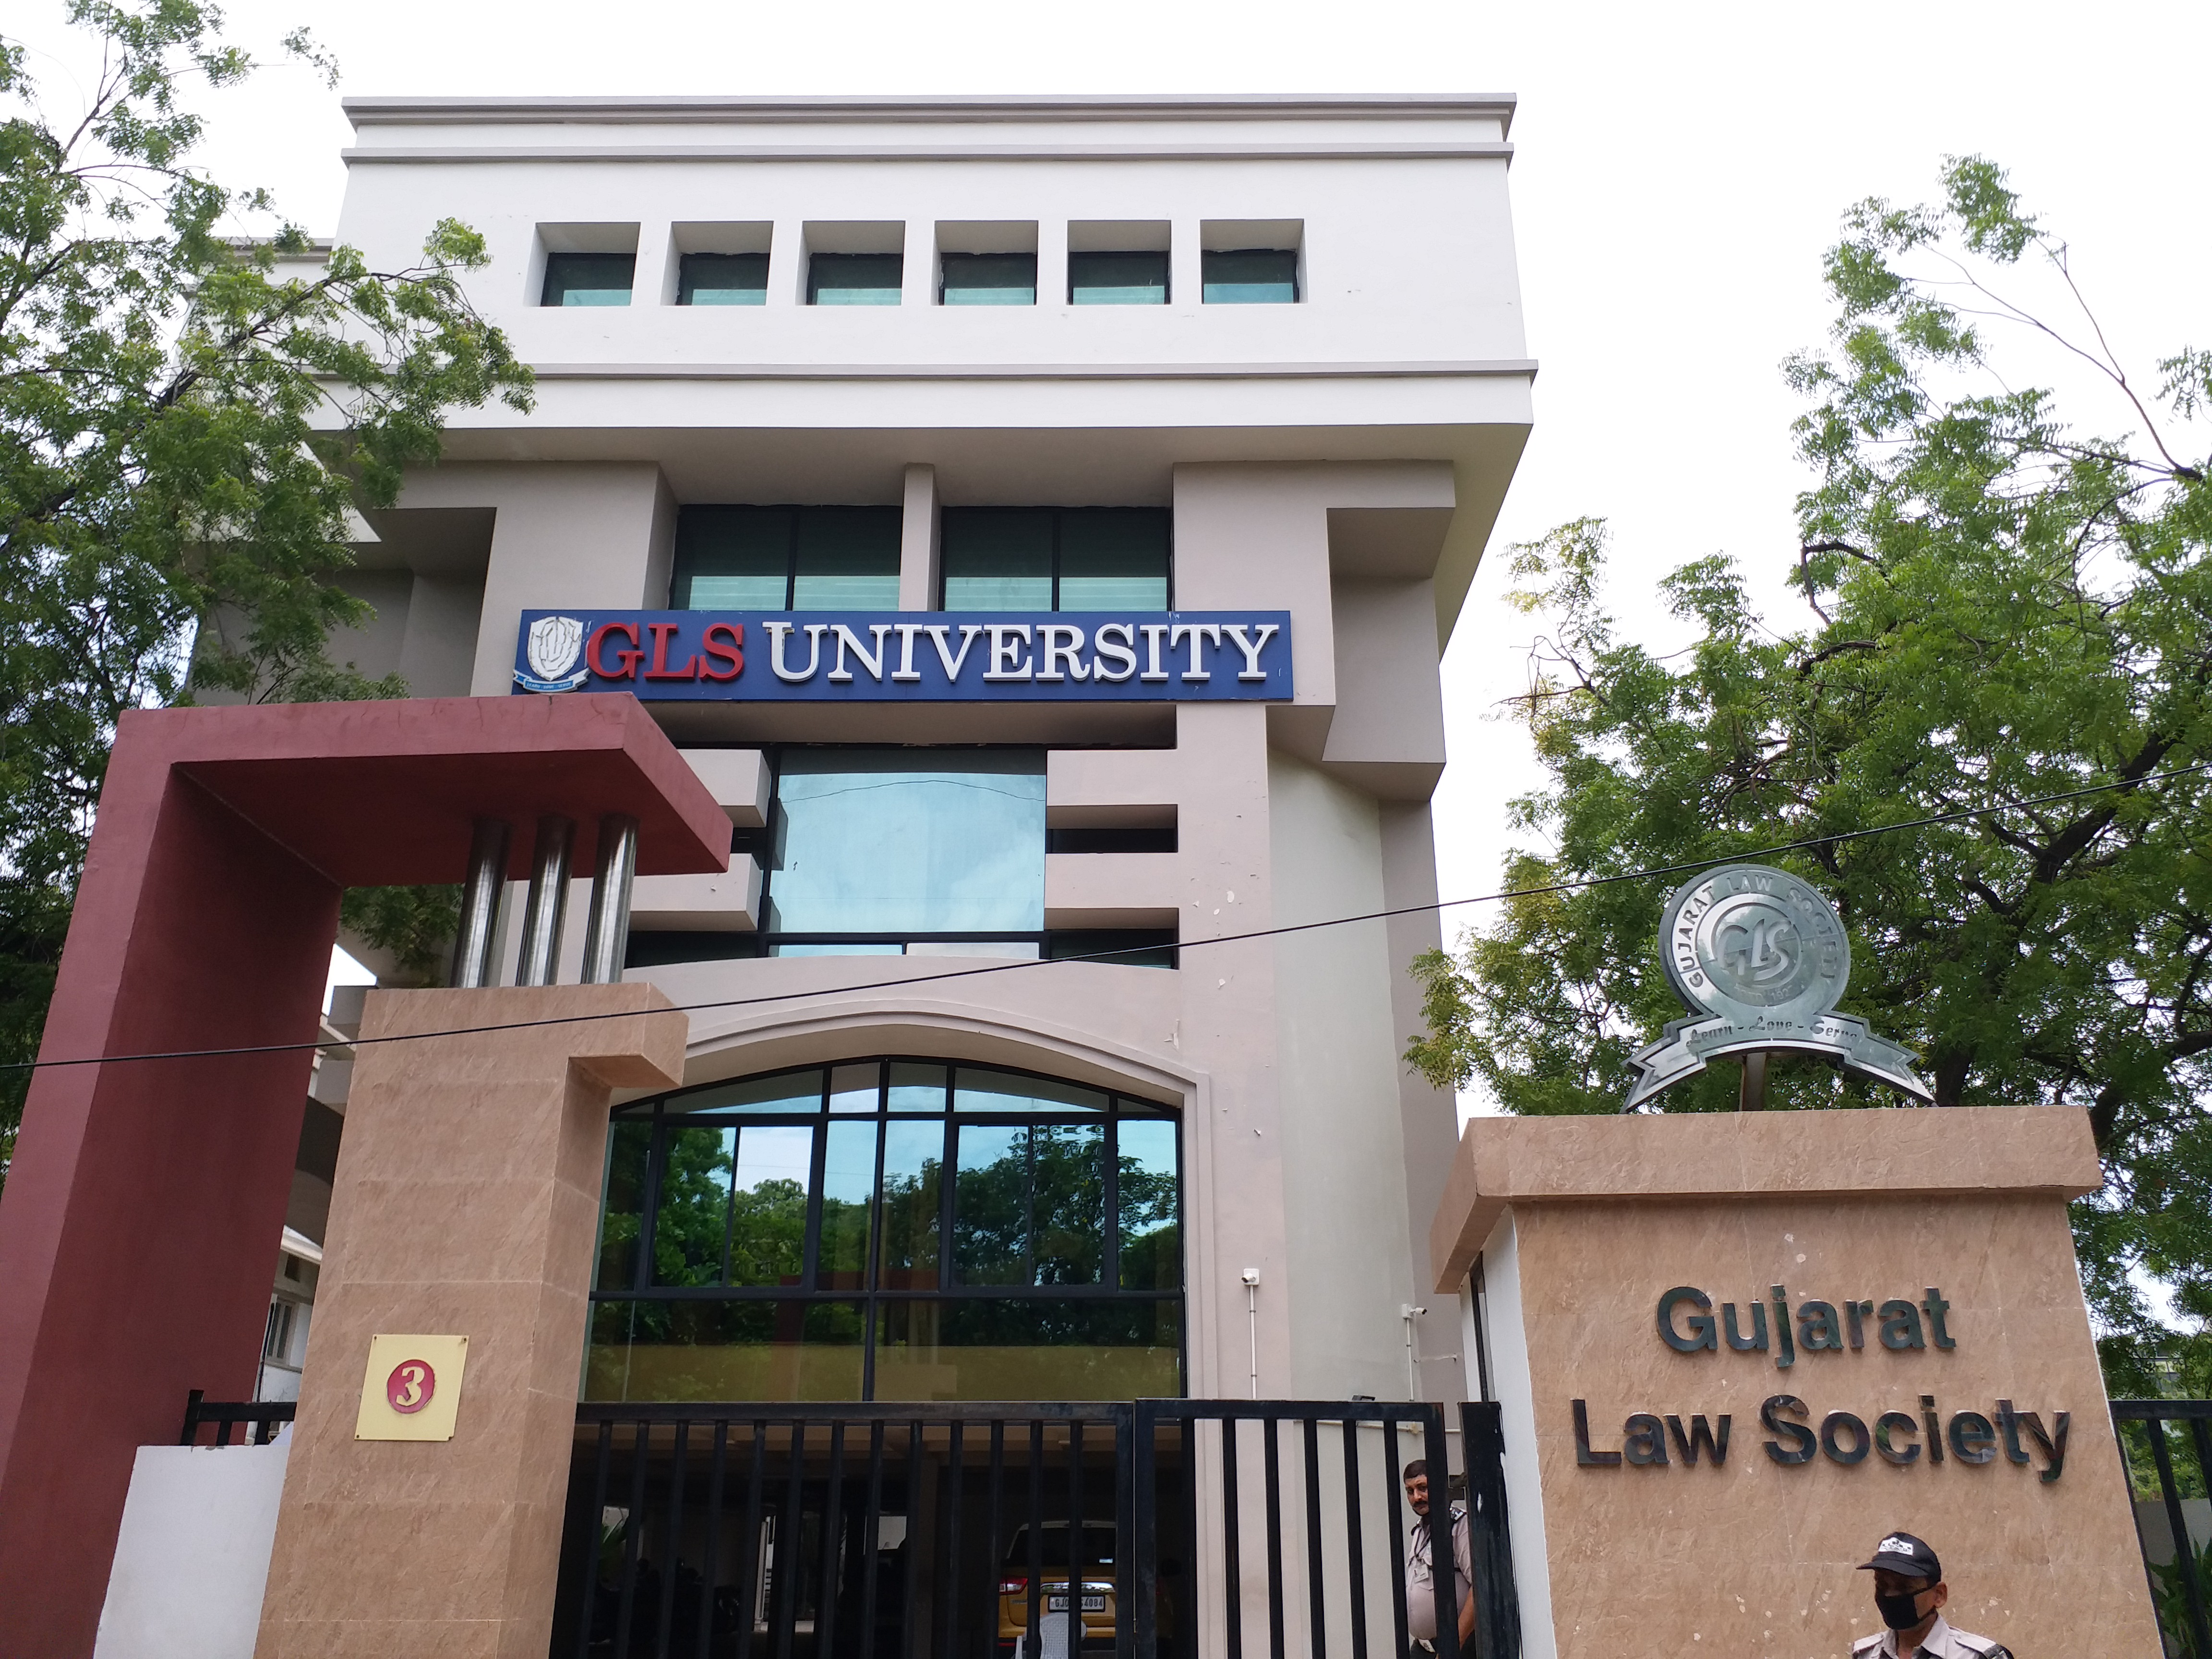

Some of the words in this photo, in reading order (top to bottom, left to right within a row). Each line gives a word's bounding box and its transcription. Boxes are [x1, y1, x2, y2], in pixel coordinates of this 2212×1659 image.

[587, 622, 744, 681] GLS
[762, 622, 1279, 683] UNIVERSITY
[1678, 886, 1715, 987] GUJARAT
[1727, 875, 1773, 892] LAW
[1686, 1025, 1733, 1047] Learn
[1749, 1015, 1792, 1032] Love
[1656, 1284, 1957, 1368] Gujarat
[396, 1366, 425, 1407] 3
[1570, 1398, 1732, 1467] Law
[1759, 1394, 2071, 1482] Society
